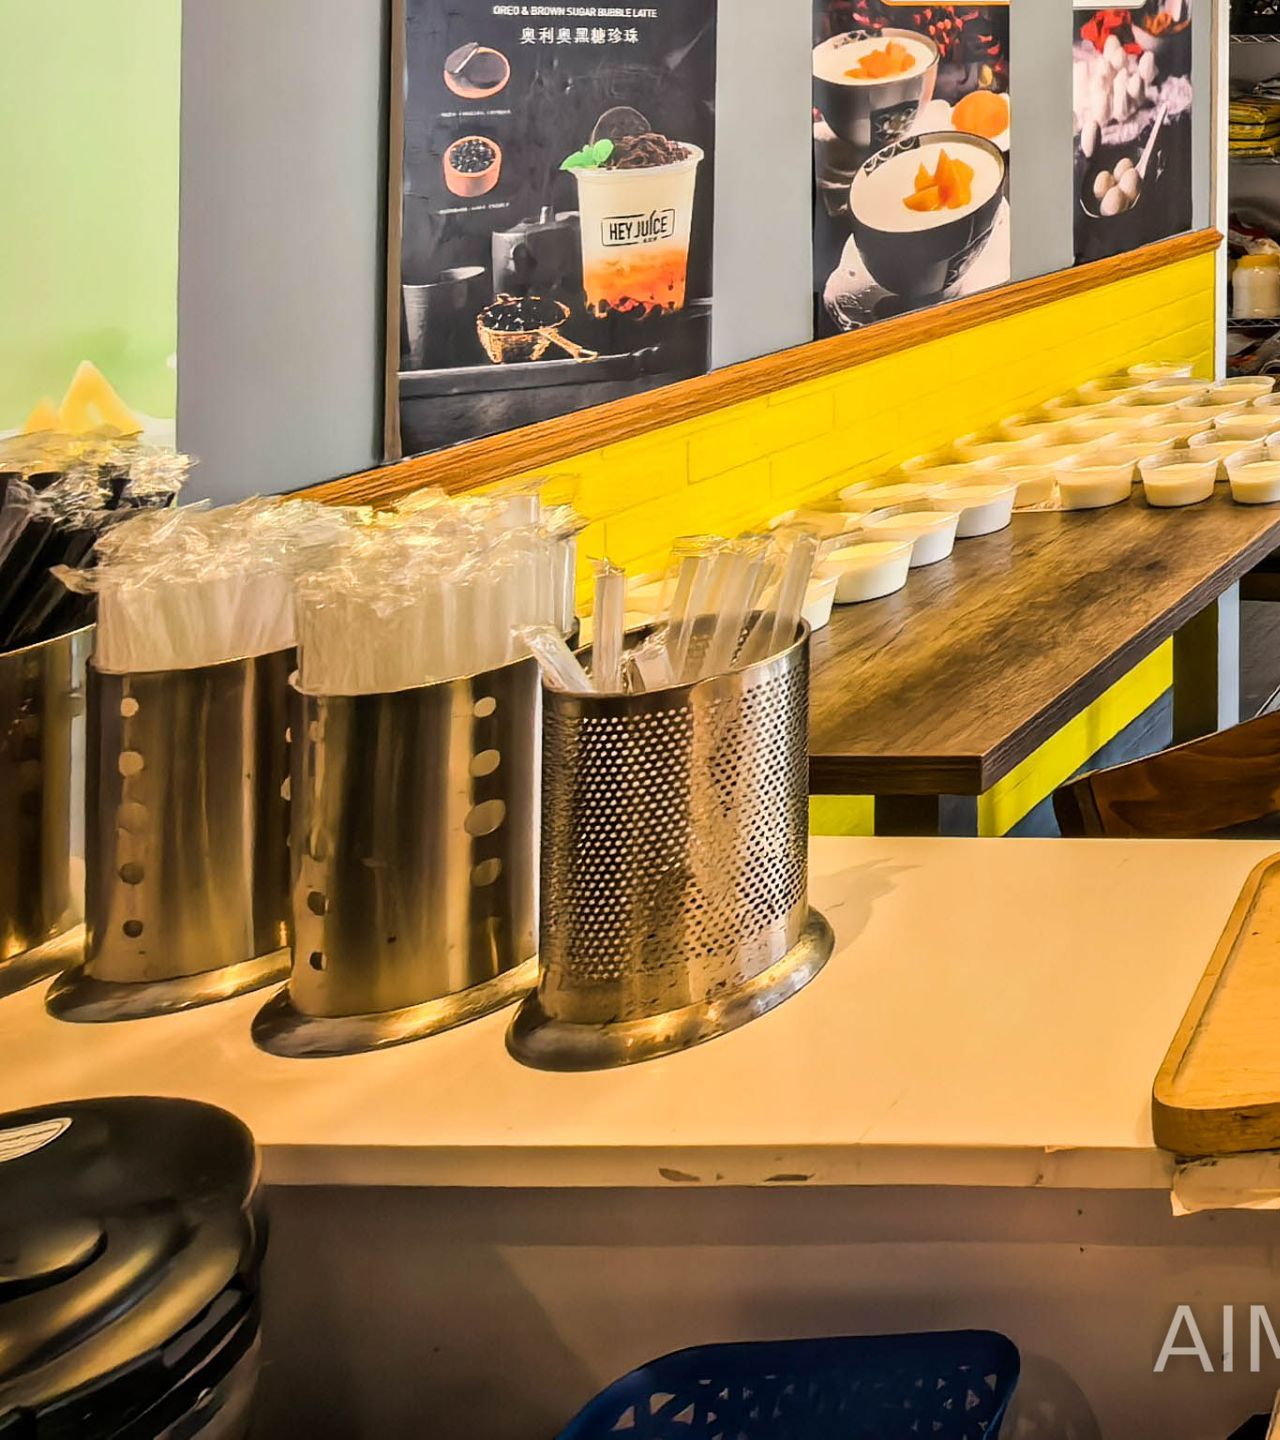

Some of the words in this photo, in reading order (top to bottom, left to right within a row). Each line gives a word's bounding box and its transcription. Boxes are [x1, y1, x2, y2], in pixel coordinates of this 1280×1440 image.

[493, 5, 519, 16] OREO
[521, 5, 529, 16] &
[530, 5, 565, 16] BROWN
[566, 7, 596, 17] SUGAR
[597, 7, 632, 18] BUBBLE
[632, 9, 659, 18] LATTE
[609, 220, 635, 241] HEY
[635, 210, 668, 239] JUICE
